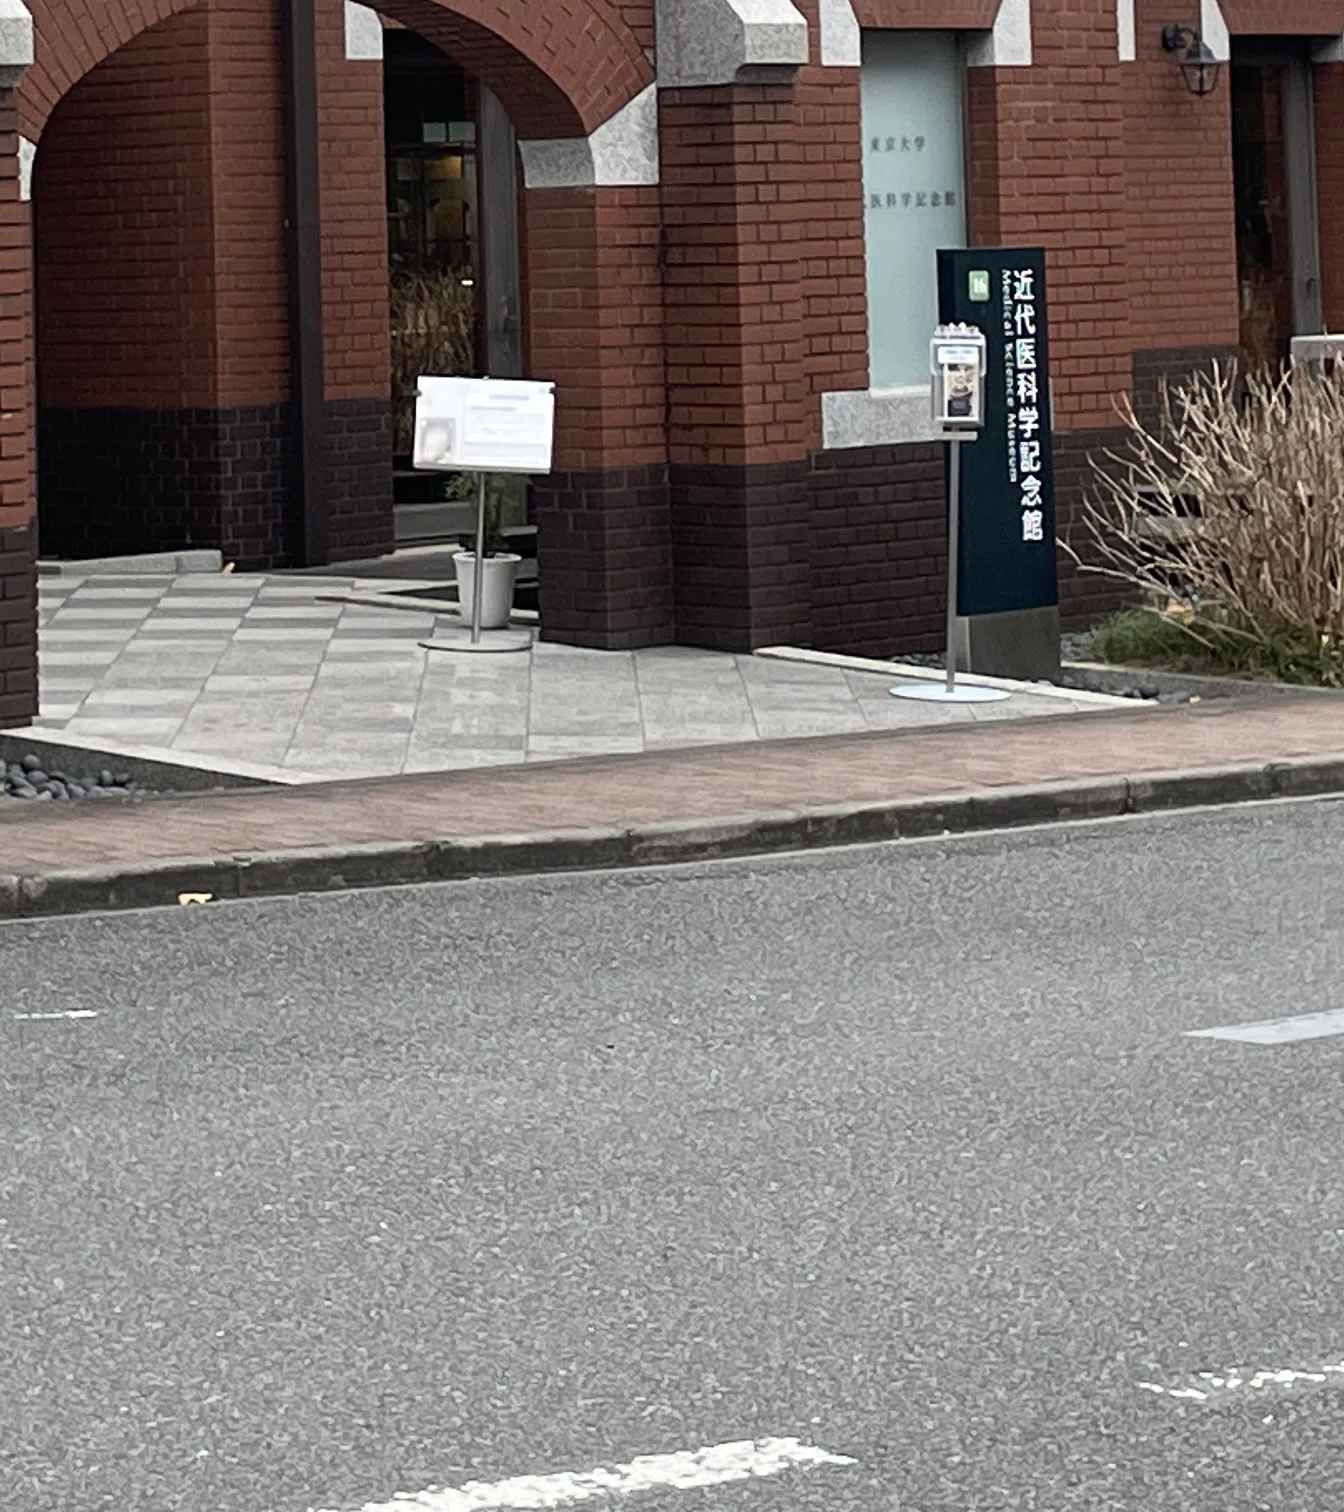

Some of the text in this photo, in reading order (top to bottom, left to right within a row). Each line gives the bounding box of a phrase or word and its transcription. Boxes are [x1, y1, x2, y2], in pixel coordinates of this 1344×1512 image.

[864, 191, 956, 208] 医科学記念館
[1001, 269, 1018, 483] Medical Science Museum
[1013, 268, 1044, 541] 近代医科学記念館
